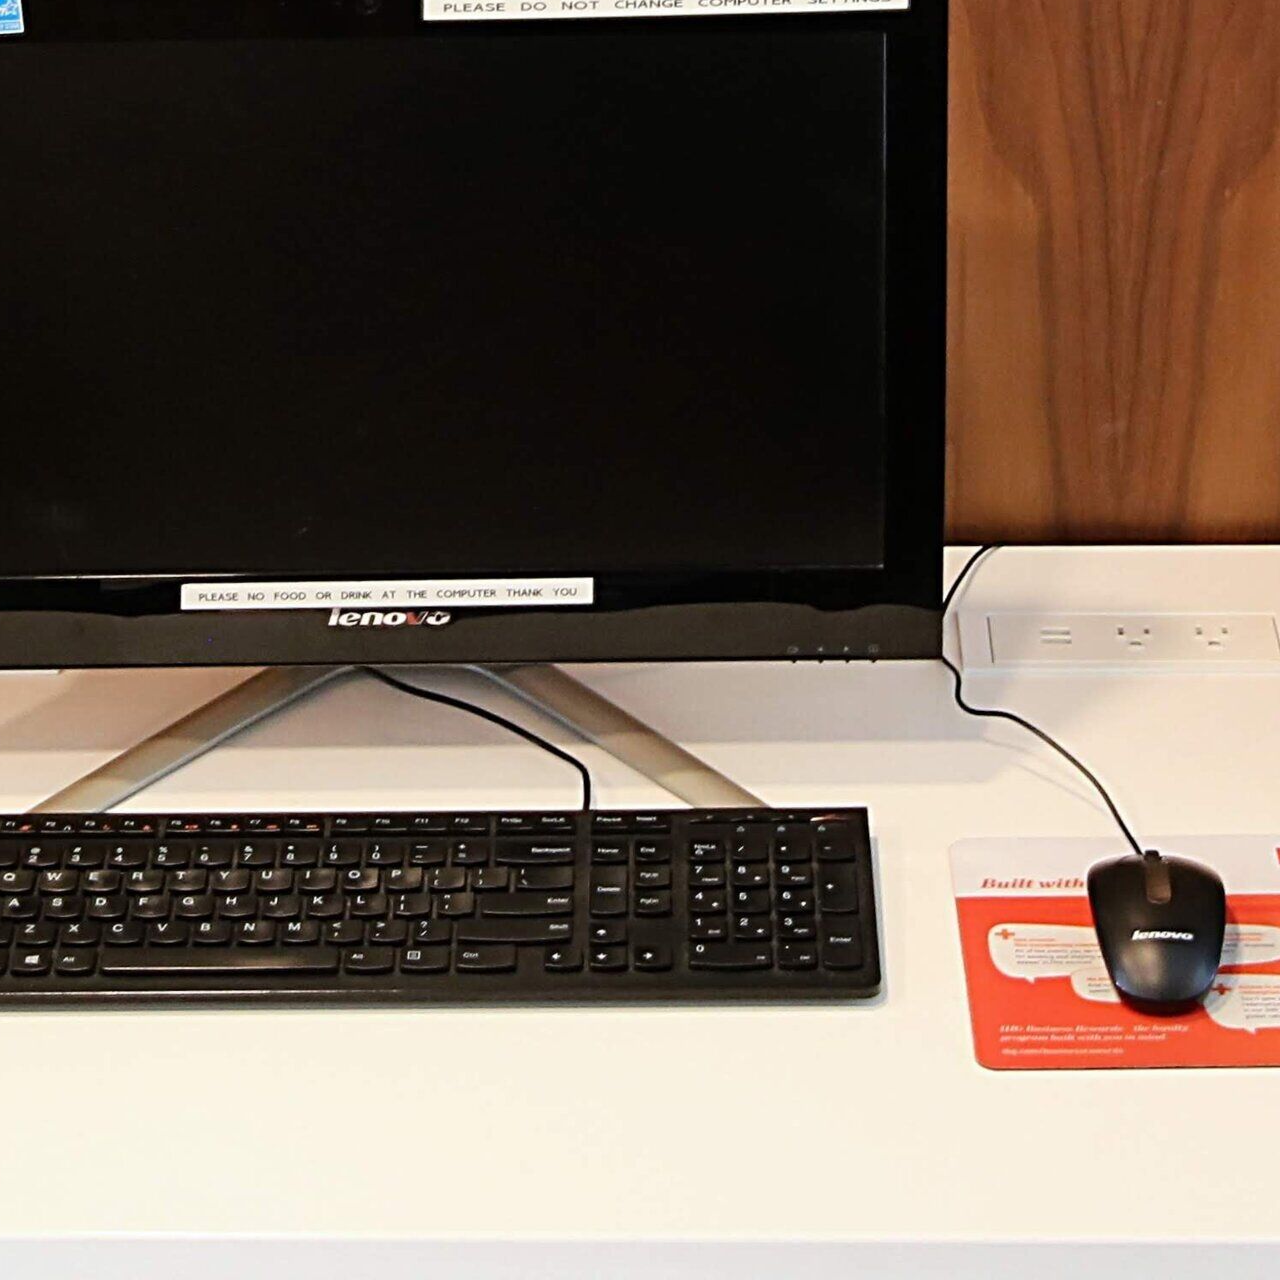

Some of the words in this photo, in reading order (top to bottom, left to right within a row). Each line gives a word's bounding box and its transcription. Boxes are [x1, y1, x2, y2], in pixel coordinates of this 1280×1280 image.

[443, 2, 506, 12] PLEASE
[520, 2, 546, 11] DO
[562, 1, 599, 10] NOT
[615, 0, 683, 9] CHANGE
[198, 592, 238, 601] PLEASE
[248, 592, 265, 601] NO
[274, 592, 306, 600] FOOD
[341, 591, 372, 599] DRINK
[382, 591, 396, 599] AT
[407, 590, 427, 598] THE
[437, 589, 496, 598] COMPUTER
[506, 588, 543, 597] THANK
[552, 588, 577, 596] YOU
[328, 608, 451, 626] lenovo
[28, 855, 37, 863] 2
[157, 854, 166, 862] 5
[329, 852, 338, 860] 9
[372, 852, 381, 860] 0
[3, 872, 16, 881] Q
[47, 872, 62, 881] W
[89, 872, 99, 881] E
[132, 872, 143, 880] R
[177, 872, 188, 880] T
[262, 871, 273, 879] U
[348, 871, 361, 879] O
[391, 870, 401, 878] P
[695, 866, 703, 874] 7
[982, 878, 1032, 889] Built
[1039, 878, 1084, 888] with
[9, 898, 19, 907] A
[52, 898, 63, 906] S
[95, 898, 107, 906] D
[138, 897, 149, 906] F
[182, 897, 194, 905] G
[226, 897, 237, 905] H
[270, 897, 278, 905] J
[313, 896, 323, 904] K
[357, 896, 365, 904] L
[695, 892, 703, 900] 4
[25, 924, 35, 933] Z
[69, 924, 79, 933] X
[112, 923, 124, 932] C
[158, 923, 168, 931] V
[200, 923, 211, 931] B
[244, 923, 255, 931] N
[288, 922, 302, 931] M
[740, 918, 748, 926] 2
[784, 918, 792, 926] 3
[1132, 930, 1194, 941] lenovo
[696, 944, 704, 952] 0
